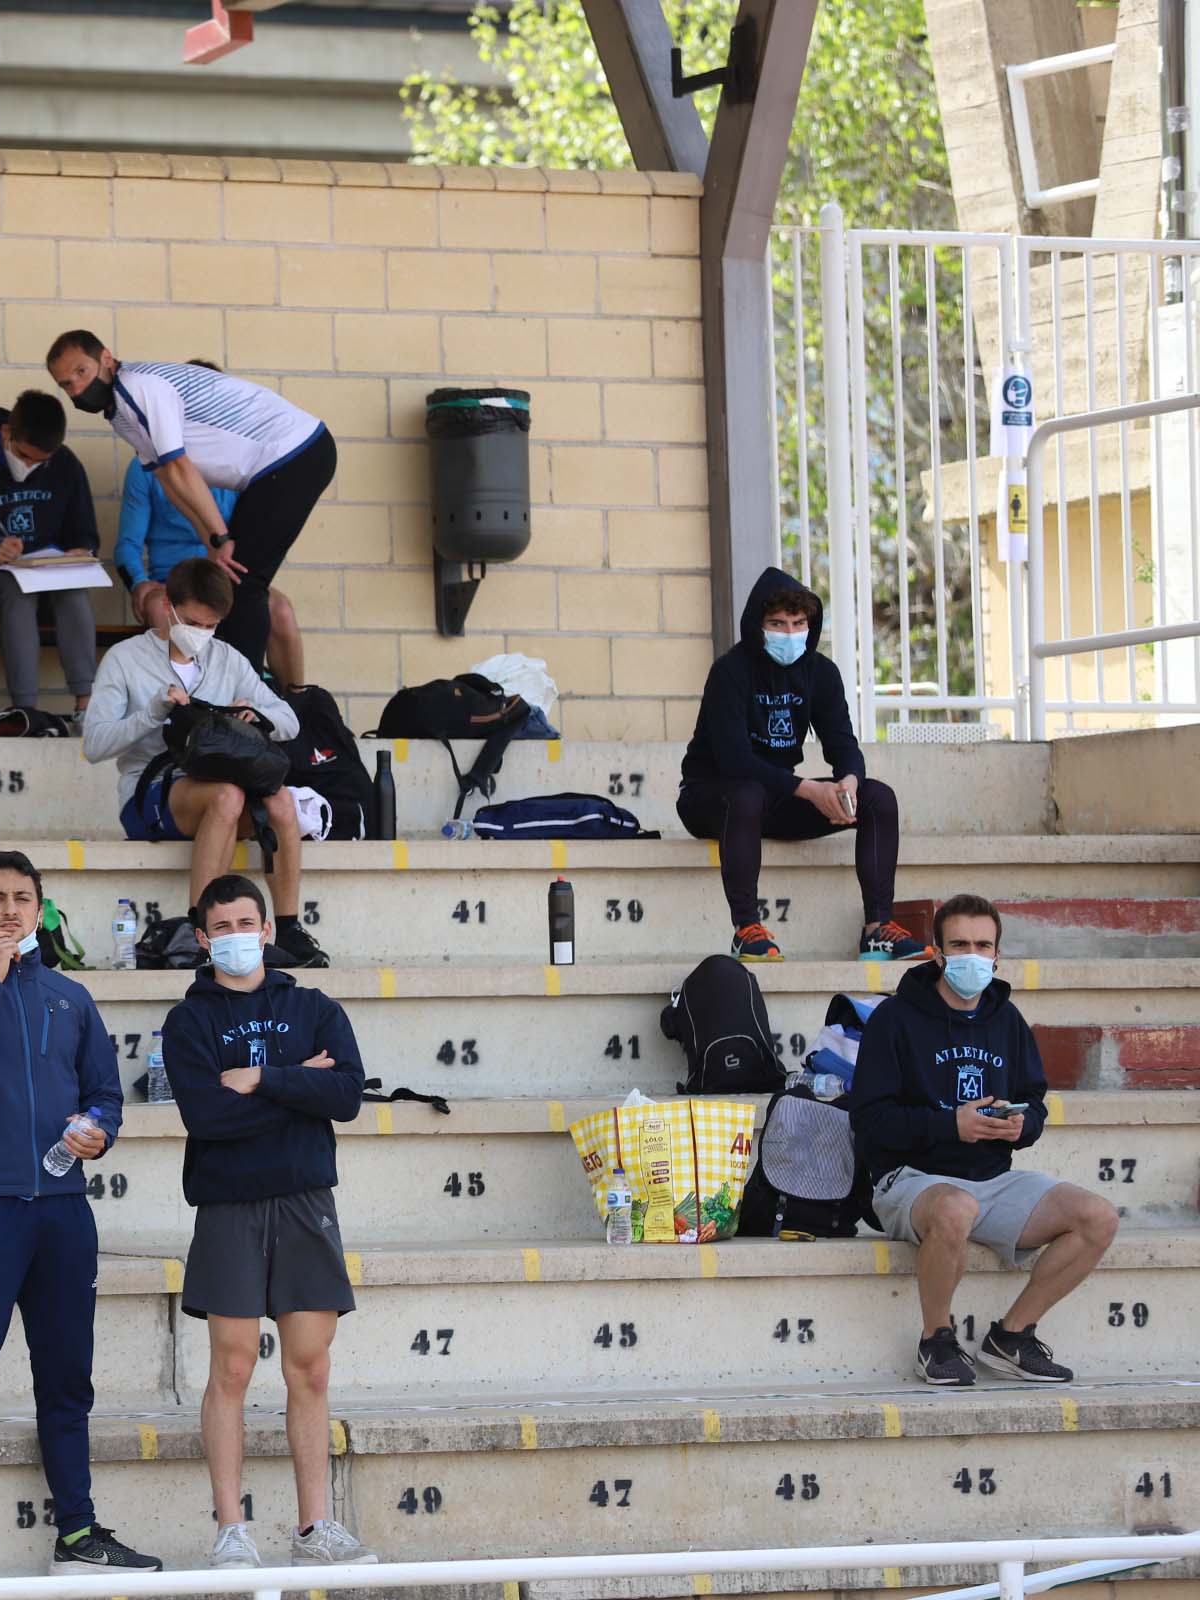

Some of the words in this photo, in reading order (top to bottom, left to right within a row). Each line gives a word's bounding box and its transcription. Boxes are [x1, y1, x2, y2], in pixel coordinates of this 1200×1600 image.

[609, 773, 644, 796] 37
[304, 902, 320, 925] 3
[452, 901, 485, 923] 41
[606, 900, 643, 922] 39
[437, 1040, 479, 1066] 43
[605, 1035, 640, 1059] 41
[935, 1046, 1004, 1068] ATLETICO
[1099, 1159, 1136, 1183] 37
[87, 1173, 128, 1199] 49
[444, 1172, 485, 1197] 45
[1108, 1303, 1148, 1327] 39
[411, 1329, 453, 1355] 47
[594, 1323, 637, 1348] 45
[774, 1319, 814, 1343] 43
[260, 1333, 275, 1359] 9
[589, 1480, 632, 1507] 47
[776, 1474, 820, 1500] 45
[953, 1468, 996, 1495] 43
[1135, 1472, 1171, 1498] 41
[397, 1487, 442, 1514] 49
